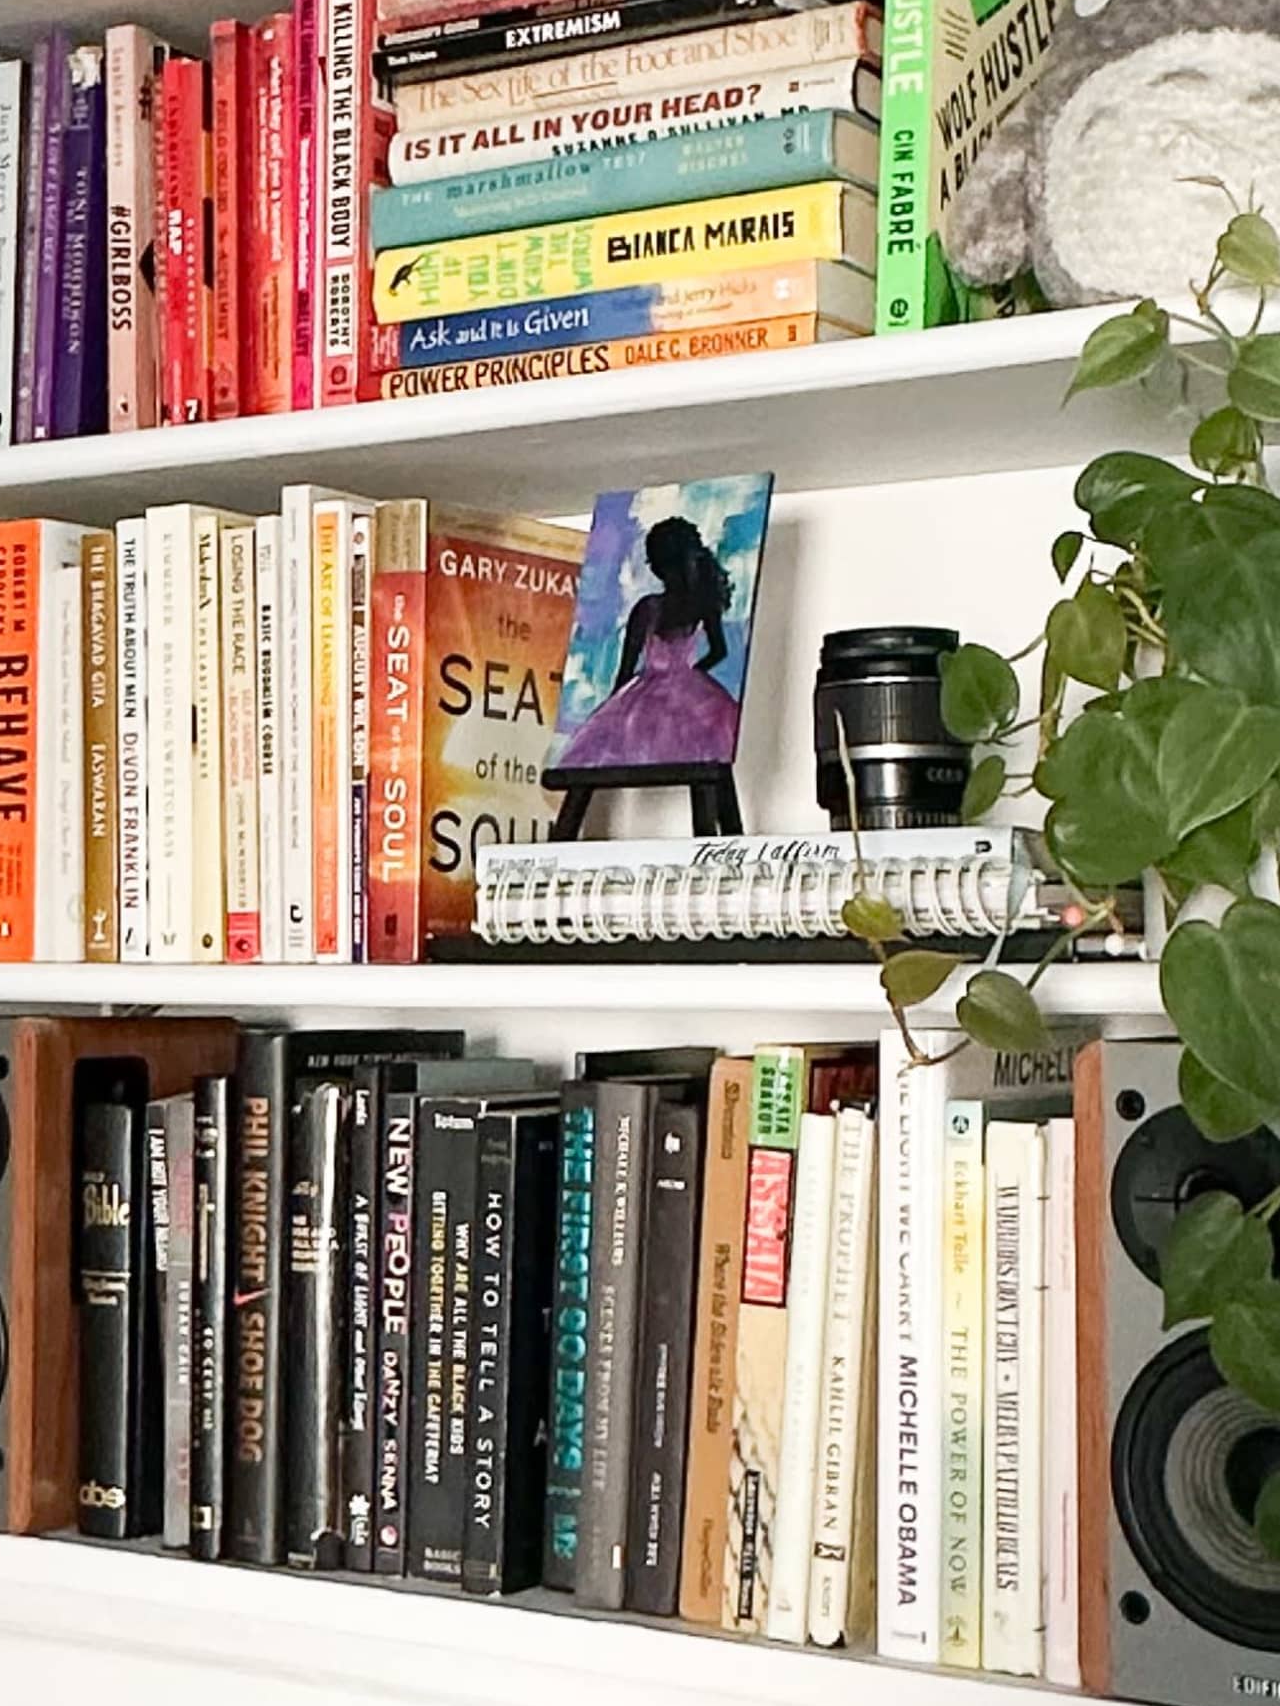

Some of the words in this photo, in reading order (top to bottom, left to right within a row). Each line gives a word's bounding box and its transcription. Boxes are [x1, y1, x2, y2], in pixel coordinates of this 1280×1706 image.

[333, 2, 354, 79] KILLING
[505, 10, 621, 49] EXTREMISM
[461, 79, 503, 103] Sex
[580, 52, 617, 81] the
[682, 25, 729, 63] and
[732, 25, 797, 57] Shoe
[332, 84, 354, 122] THE
[404, 139, 431, 162] IS
[437, 132, 467, 156] IT
[471, 124, 525, 151] ALL
[532, 118, 563, 141] IN
[572, 101, 652, 134] YOUR
[660, 84, 762, 120] HEAD?
[935, 69, 978, 151] WOLF
[332, 127, 353, 191] BLACK
[892, 130, 915, 163] CIN
[330, 196, 352, 247] BODY
[607, 227, 696, 263] BIANCA
[704, 210, 796, 251] MARAIS
[110, 205, 132, 331] #GIRLBOSS
[329, 275, 340, 347] ROBERTS
[341, 274, 352, 347] DOROTHY
[410, 319, 451, 353] Ask
[455, 317, 487, 345] and
[524, 305, 590, 335] Given
[389, 365, 470, 399] POWER
[474, 344, 610, 389] PRINCIPLES
[625, 339, 667, 366] DALE
[689, 327, 769, 357] BRONNER
[90, 546, 107, 575] THE
[124, 538, 137, 567] THE
[231, 534, 246, 594] LOSING
[321, 524, 336, 553] THE
[439, 549, 508, 583] GARY
[12, 544, 26, 613] ROBERT
[124, 572, 137, 614] TRUTH
[320, 561, 336, 590] ART
[320, 596, 334, 617] OF
[393, 594, 405, 620] the
[90, 580, 107, 666] BHAGAVAD
[231, 598, 245, 625] THE
[498, 612, 531, 642] the
[123, 616, 137, 680] ABOUT
[231, 632, 246, 676] RACE
[320, 624, 335, 707] LEARNING
[387, 625, 410, 723] SEAT
[90, 671, 107, 709] GITA
[123, 684, 136, 718] MEN
[89, 743, 108, 838] EASWARAN
[476, 757, 501, 783] of
[504, 754, 538, 785] the
[123, 805, 139, 910] FRANKLIN
[382, 779, 407, 883] SOUL
[246, 1097, 269, 1162] PHIL
[757, 1066, 776, 1135] SHAKUR
[148, 1136, 166, 1159] AM
[386, 1117, 412, 1196] NEW
[563, 1106, 596, 1184] THE
[615, 1116, 631, 1179] MICHAEL
[840, 1118, 863, 1181] THE
[83, 1182, 130, 1227] Bible
[152, 1188, 169, 1225] YOUR
[431, 1191, 447, 1251] SITTING
[486, 1192, 503, 1259] HOW
[952, 1160, 968, 1229] Eckhart
[241, 1170, 269, 1283] KNIGHT
[455, 1223, 470, 1259] WHY
[559, 1190, 593, 1303] FIRST
[610, 1196, 628, 1268] WILLIAMS
[745, 1153, 792, 1301] ASSATA
[832, 1191, 858, 1325] PROPHET
[951, 1233, 967, 1274] Tolle
[996, 1185, 1020, 1280] WARRIORS
[382, 1211, 412, 1336] PEOPLE
[429, 1255, 446, 1334] TOGETHER
[455, 1262, 470, 1294] ARE
[483, 1272, 500, 1308] TO
[455, 1297, 469, 1325] ALL
[556, 1306, 587, 1362] 90
[599, 1284, 616, 1354] SCENES
[239, 1311, 266, 1392] SHOE
[428, 1360, 443, 1390] THE
[429, 1337, 443, 1355] IN
[453, 1330, 468, 1360] THE
[479, 1325, 498, 1393] TELL
[950, 1327, 968, 1379] THE
[381, 1351, 400, 1425] DANZY
[452, 1363, 467, 1413] BLACK
[478, 1404, 495, 1423] A
[596, 1358, 613, 1414] FROM
[827, 1354, 846, 1436] KAHLIL
[236, 1400, 264, 1465] DOG
[424, 1393, 442, 1486] CAFETERIA?
[450, 1417, 465, 1455] KIDS
[552, 1369, 585, 1472] DAYS
[594, 1417, 609, 1441] MY
[898, 1355, 920, 1496] MICHELLE
[949, 1392, 968, 1483] POWER
[379, 1439, 399, 1511] SENNA
[473, 1437, 494, 1531] STORY
[822, 1441, 841, 1531] GIBRAN
[949, 1489, 966, 1524] OF
[896, 1501, 918, 1606] OBAMA
[947, 1536, 967, 1599] NOW
